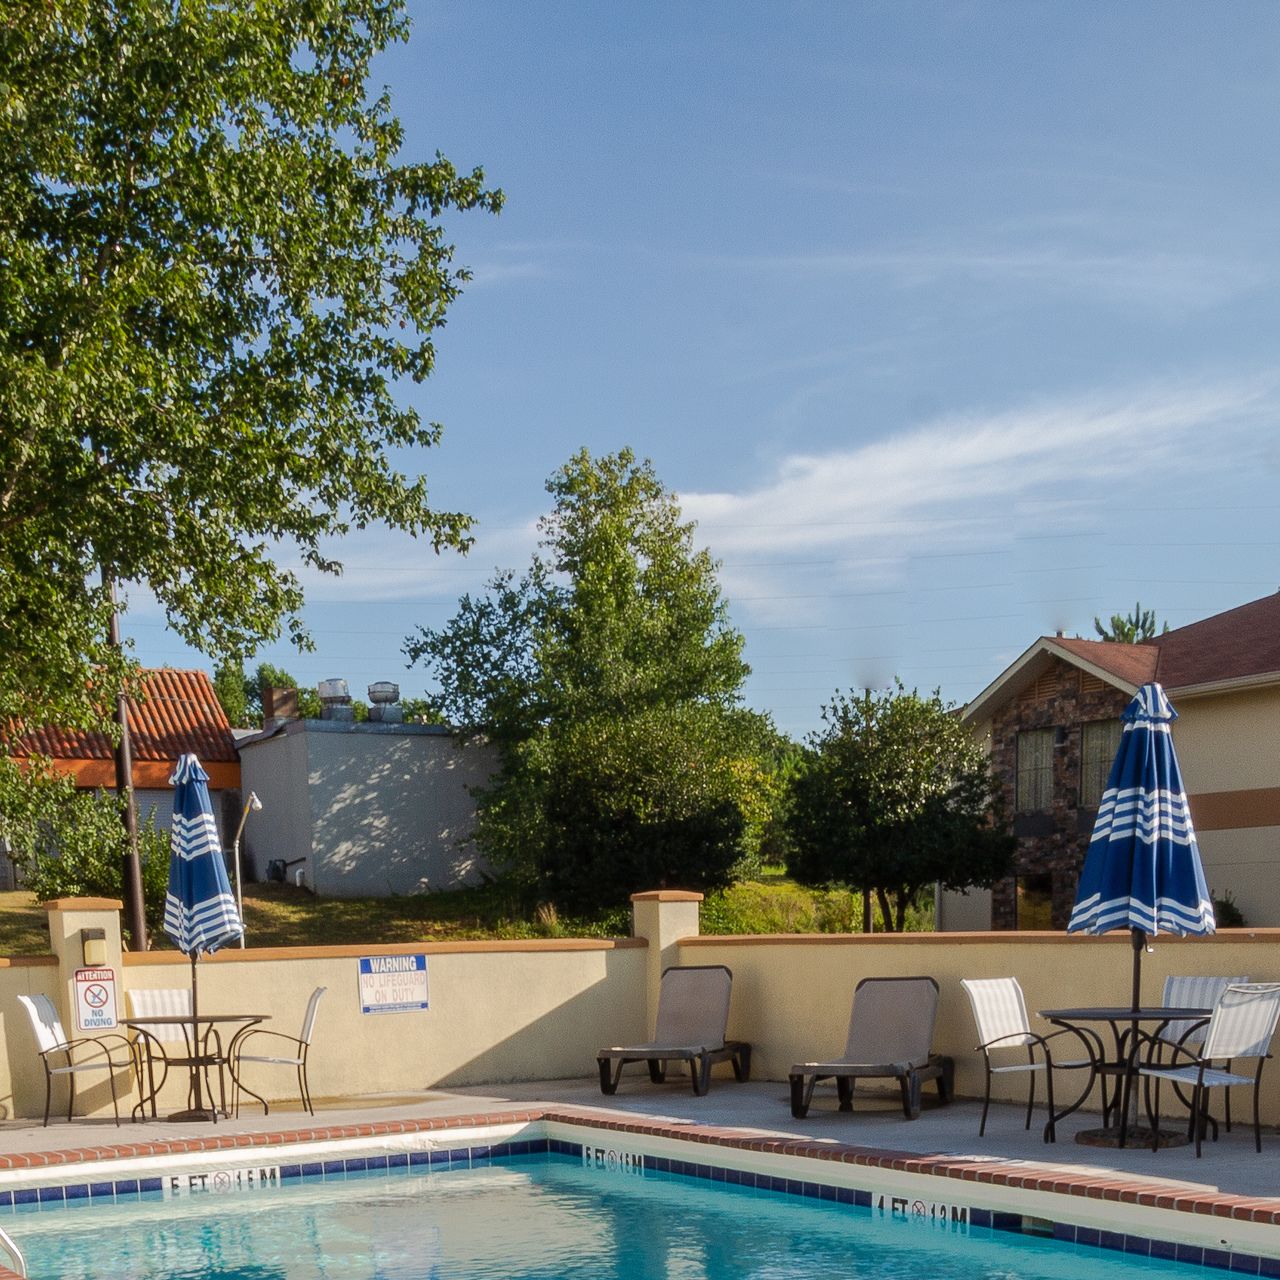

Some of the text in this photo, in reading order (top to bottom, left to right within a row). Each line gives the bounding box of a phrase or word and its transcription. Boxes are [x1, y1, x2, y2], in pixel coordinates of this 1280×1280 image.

[370, 956, 417, 973] WARNING
[77, 970, 113, 981] ATTENTION
[363, 973, 425, 988] NO LIFEGUARD
[375, 987, 415, 1003] ON DUTY
[84, 1018, 113, 1027] DIVING
[188, 1174, 209, 1189] FT
[892, 1197, 908, 1214] FT
[951, 1206, 967, 1224] M
